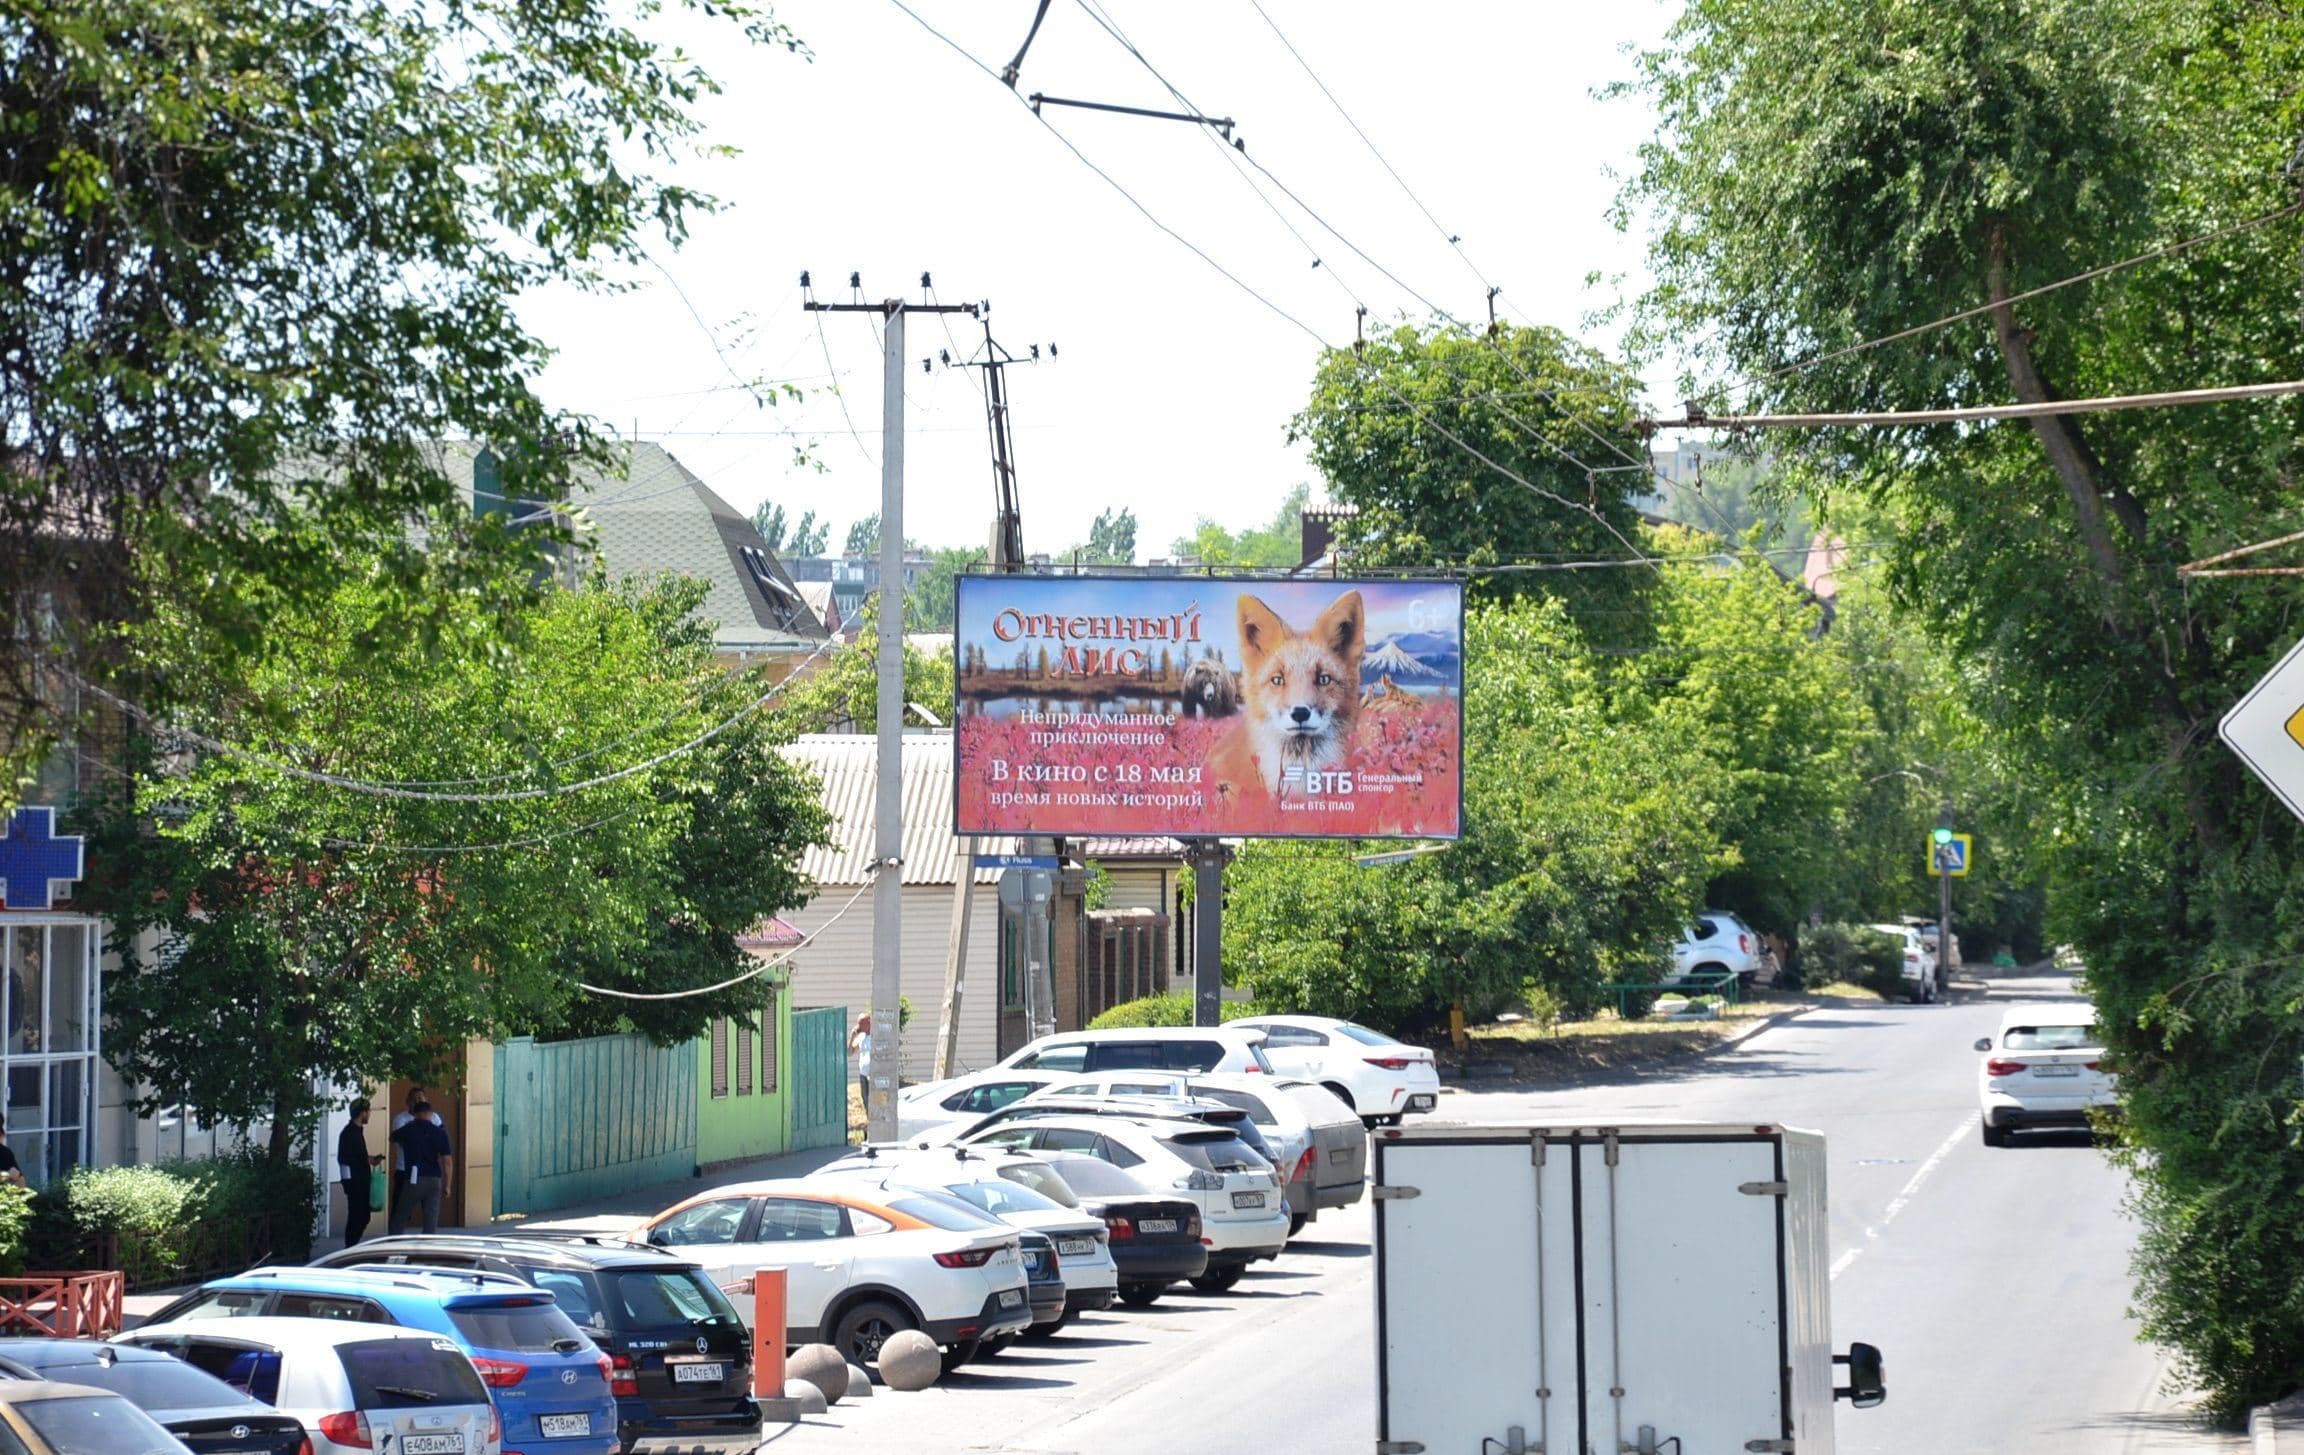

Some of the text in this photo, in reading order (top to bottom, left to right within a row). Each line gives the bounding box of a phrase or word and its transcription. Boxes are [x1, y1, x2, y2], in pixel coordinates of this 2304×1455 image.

[993, 600, 1201, 643] Огненный
[1409, 599, 1442, 629] 6+
[1020, 709, 1176, 728] Непридуманное
[1030, 730, 1166, 747] приключение
[991, 760, 1203, 783] В кино с 18 мая
[1358, 772, 1423, 784] Генеральный
[1306, 771, 1354, 794] ВТБ
[1358, 784, 1394, 794] спонсор
[991, 790, 1204, 809] время новых историй
[1281, 801, 1355, 812] Банк ВТБ (ПАО)
